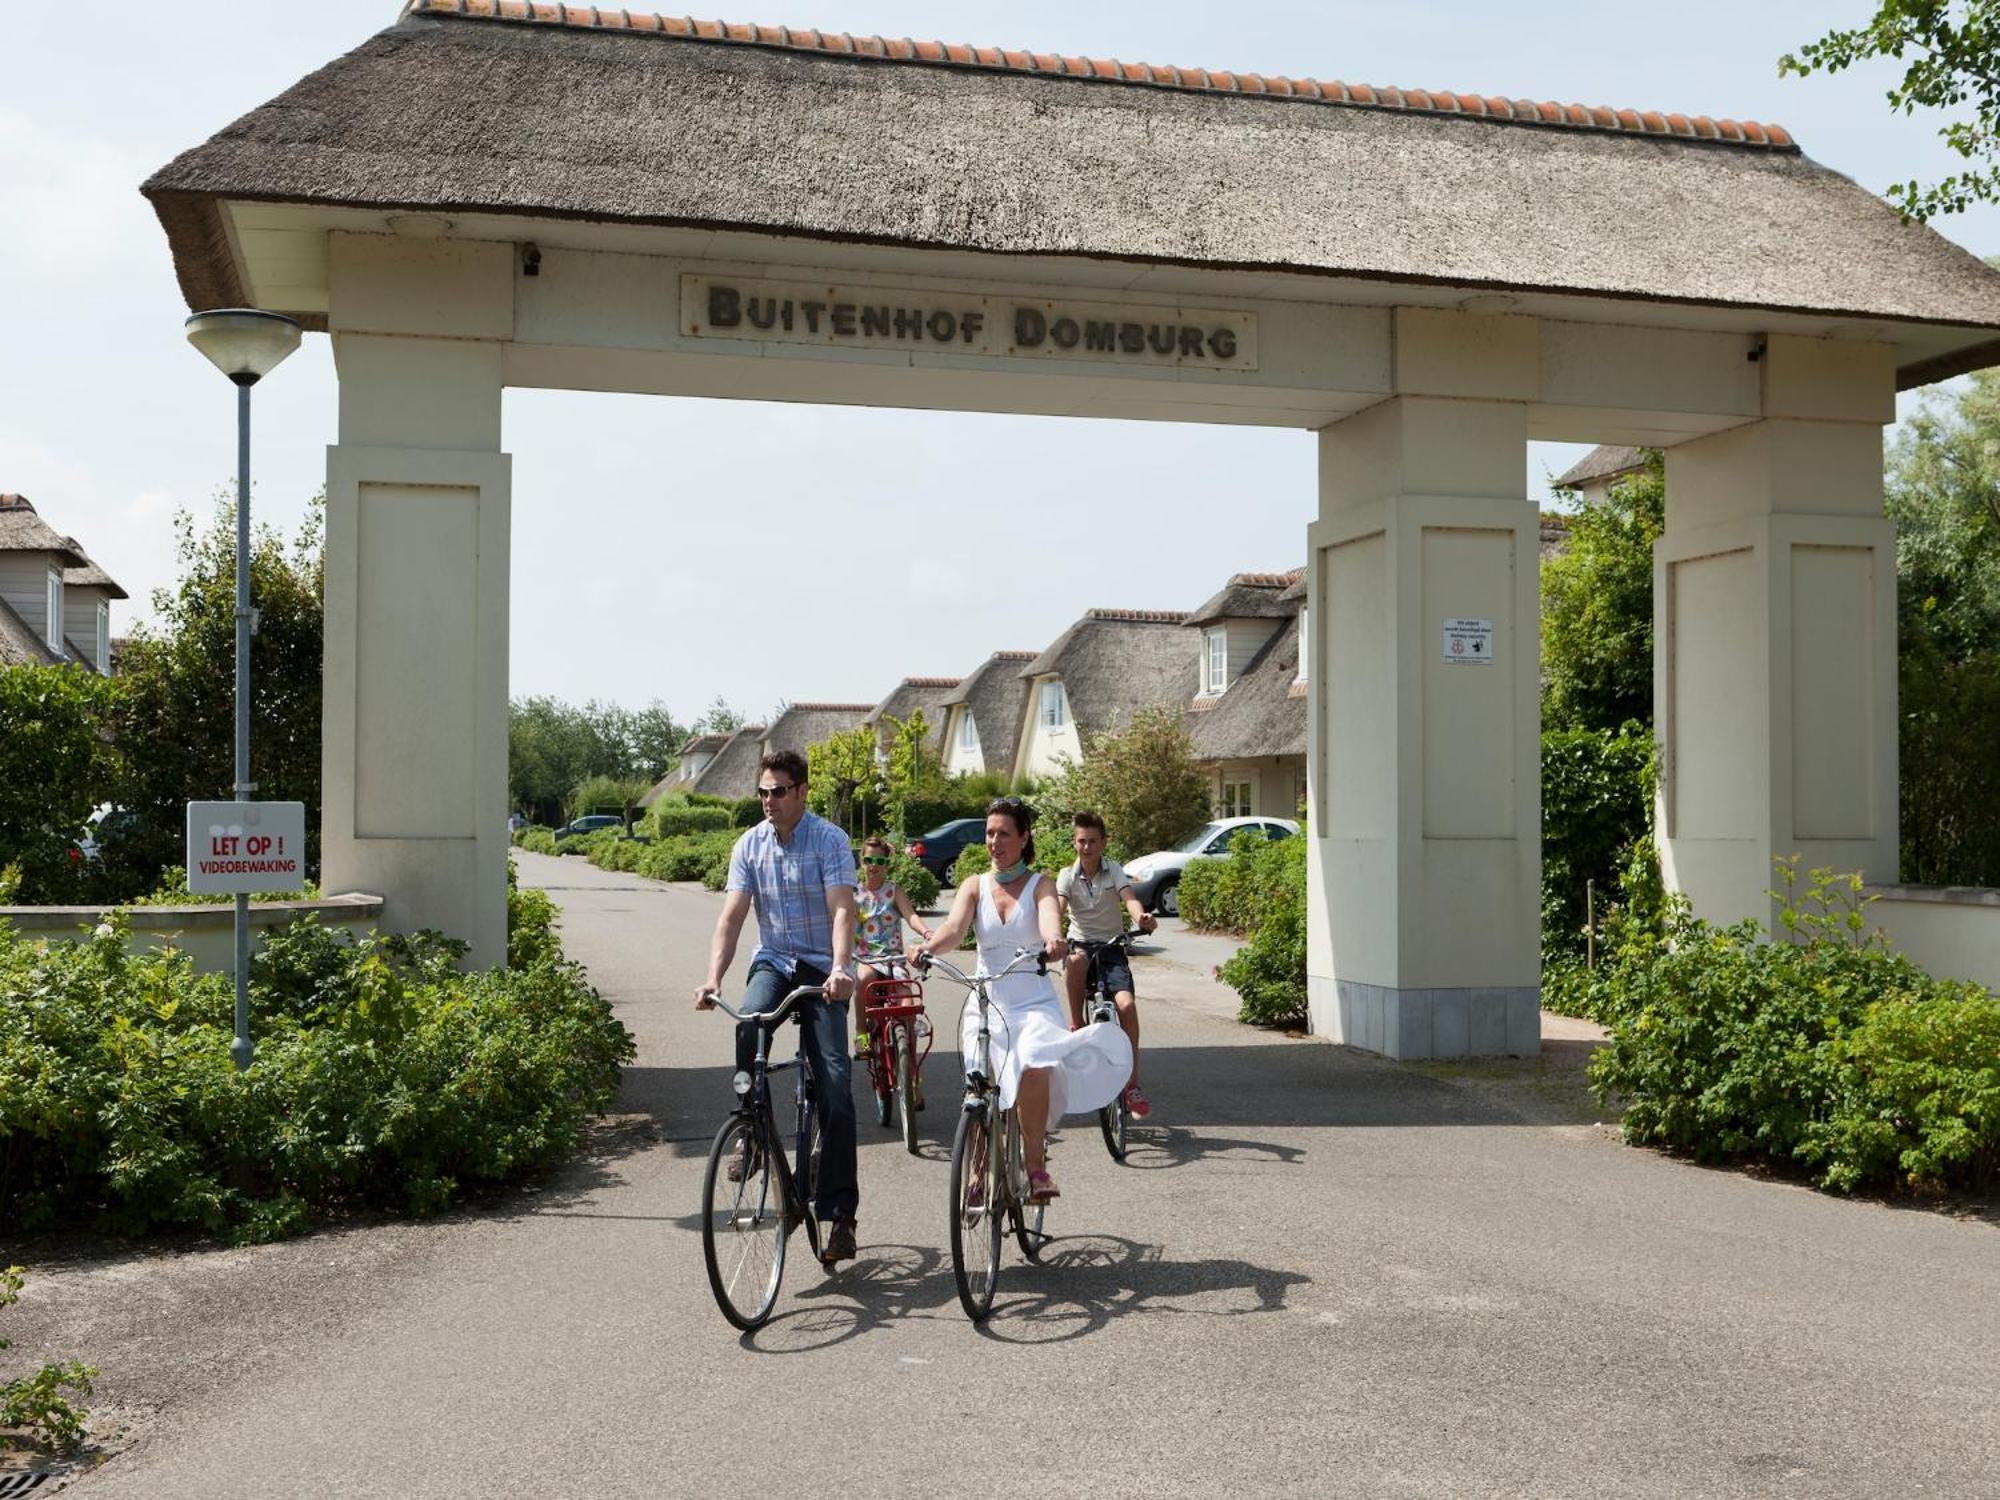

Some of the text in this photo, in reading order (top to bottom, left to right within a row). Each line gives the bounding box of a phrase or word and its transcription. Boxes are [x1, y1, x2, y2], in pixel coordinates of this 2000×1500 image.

[709, 286, 1237, 358] BUITENHOF DOMBURG
[212, 836, 239, 856] LET
[246, 836, 271, 856] OP
[200, 860, 296, 874] VIDEOBEWAKING
